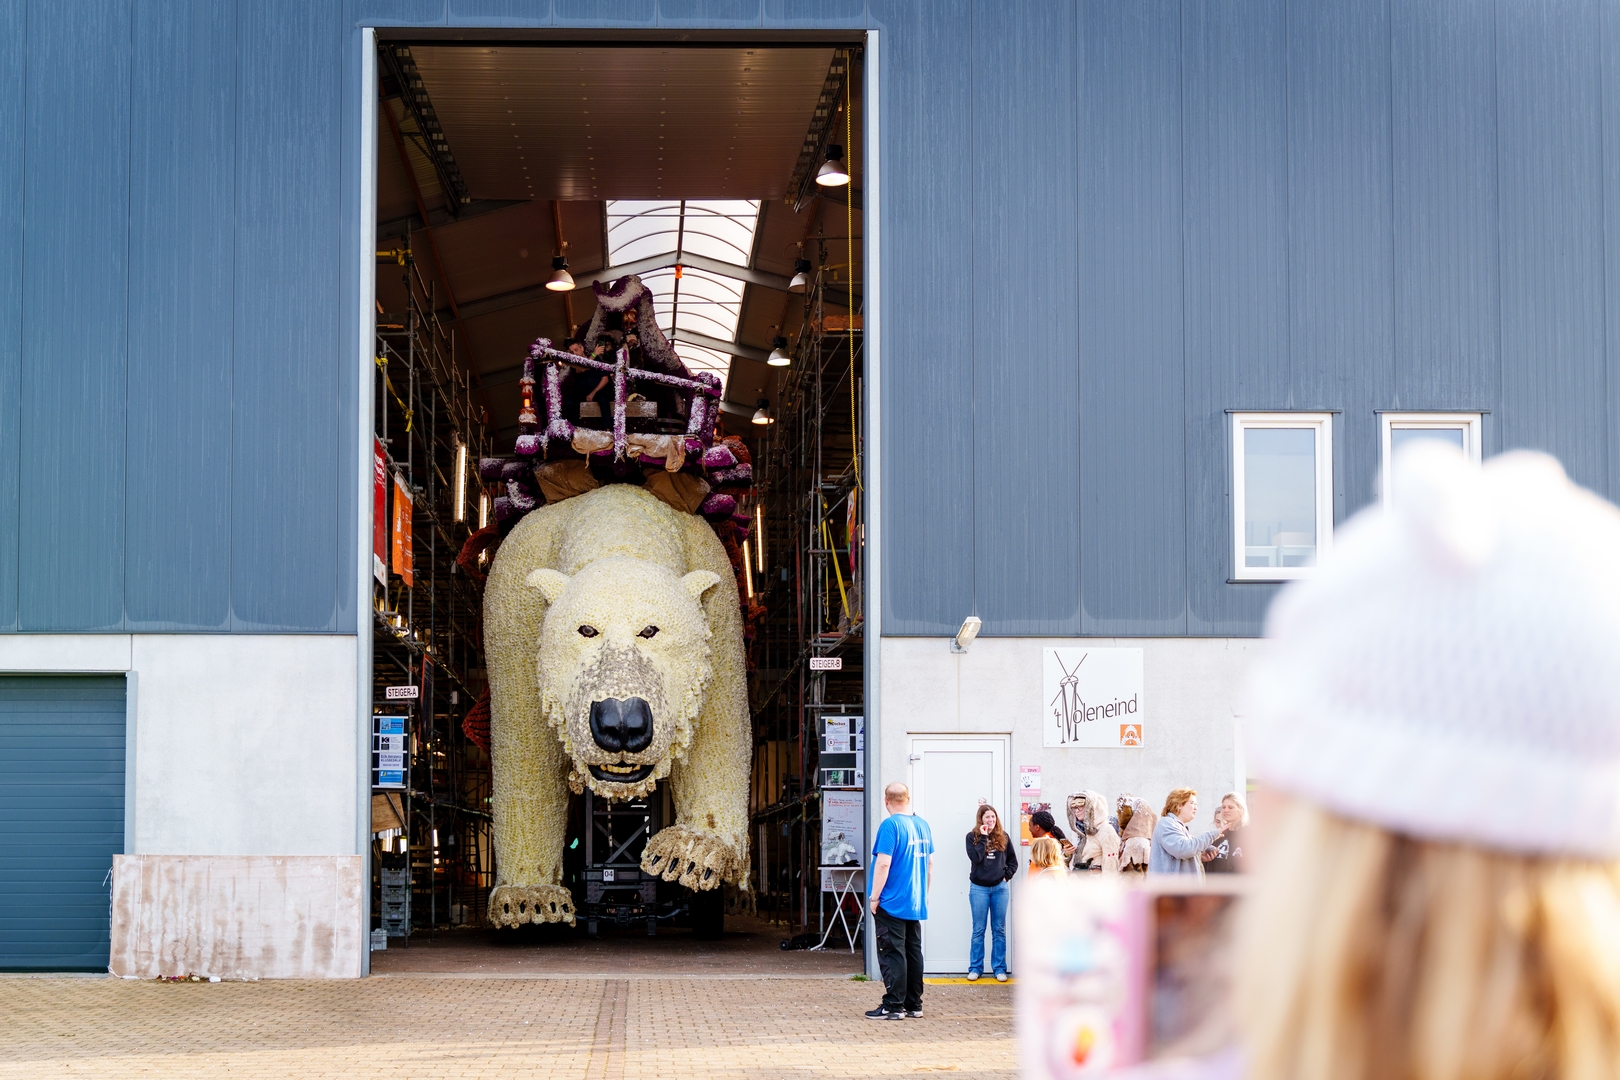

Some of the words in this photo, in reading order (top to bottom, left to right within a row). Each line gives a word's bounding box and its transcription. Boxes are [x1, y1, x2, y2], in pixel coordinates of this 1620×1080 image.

[811, 659, 841, 669] STEIGER-B
[387, 688, 417, 697] STEIGER-A
[1053, 708, 1062, 728] 't
[1060, 681, 1138, 744] Moleneind
